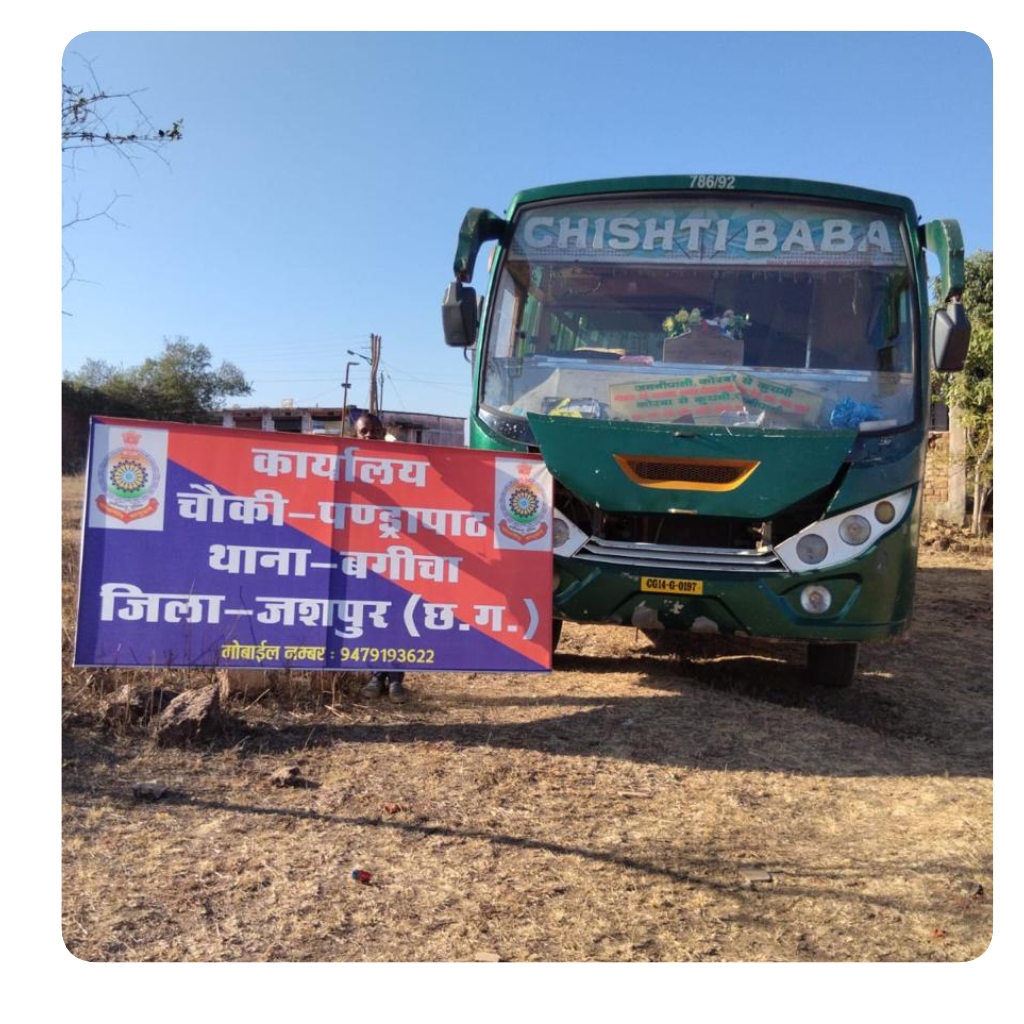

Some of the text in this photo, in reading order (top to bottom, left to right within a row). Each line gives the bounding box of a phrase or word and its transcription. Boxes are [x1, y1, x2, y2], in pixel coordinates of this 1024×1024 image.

[690, 174, 735, 189] 786/92
[523, 217, 893, 254] CHISHTI BABA
[251, 446, 430, 487] कार्यालय
[646, 578, 698, 592] CG14-G-0197
[221, 639, 280, 662] मोबाईल
[284, 645, 325, 662] नम्बर
[340, 647, 435, 664] 9479193622
